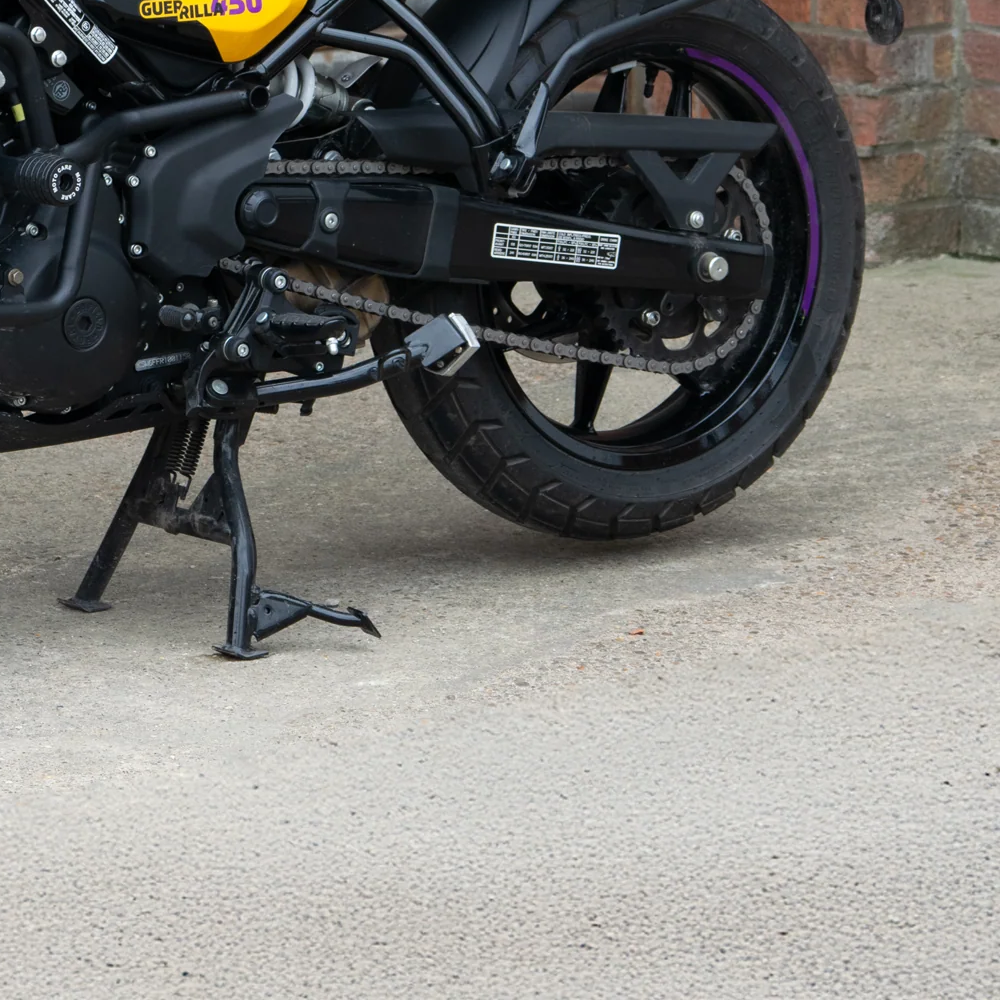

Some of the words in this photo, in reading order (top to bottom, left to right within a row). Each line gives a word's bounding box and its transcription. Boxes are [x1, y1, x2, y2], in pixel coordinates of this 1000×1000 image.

[141, 0, 225, 20] GUERRILLA
[57, 164, 72, 173] CARE
[61, 191, 76, 200] CARE
